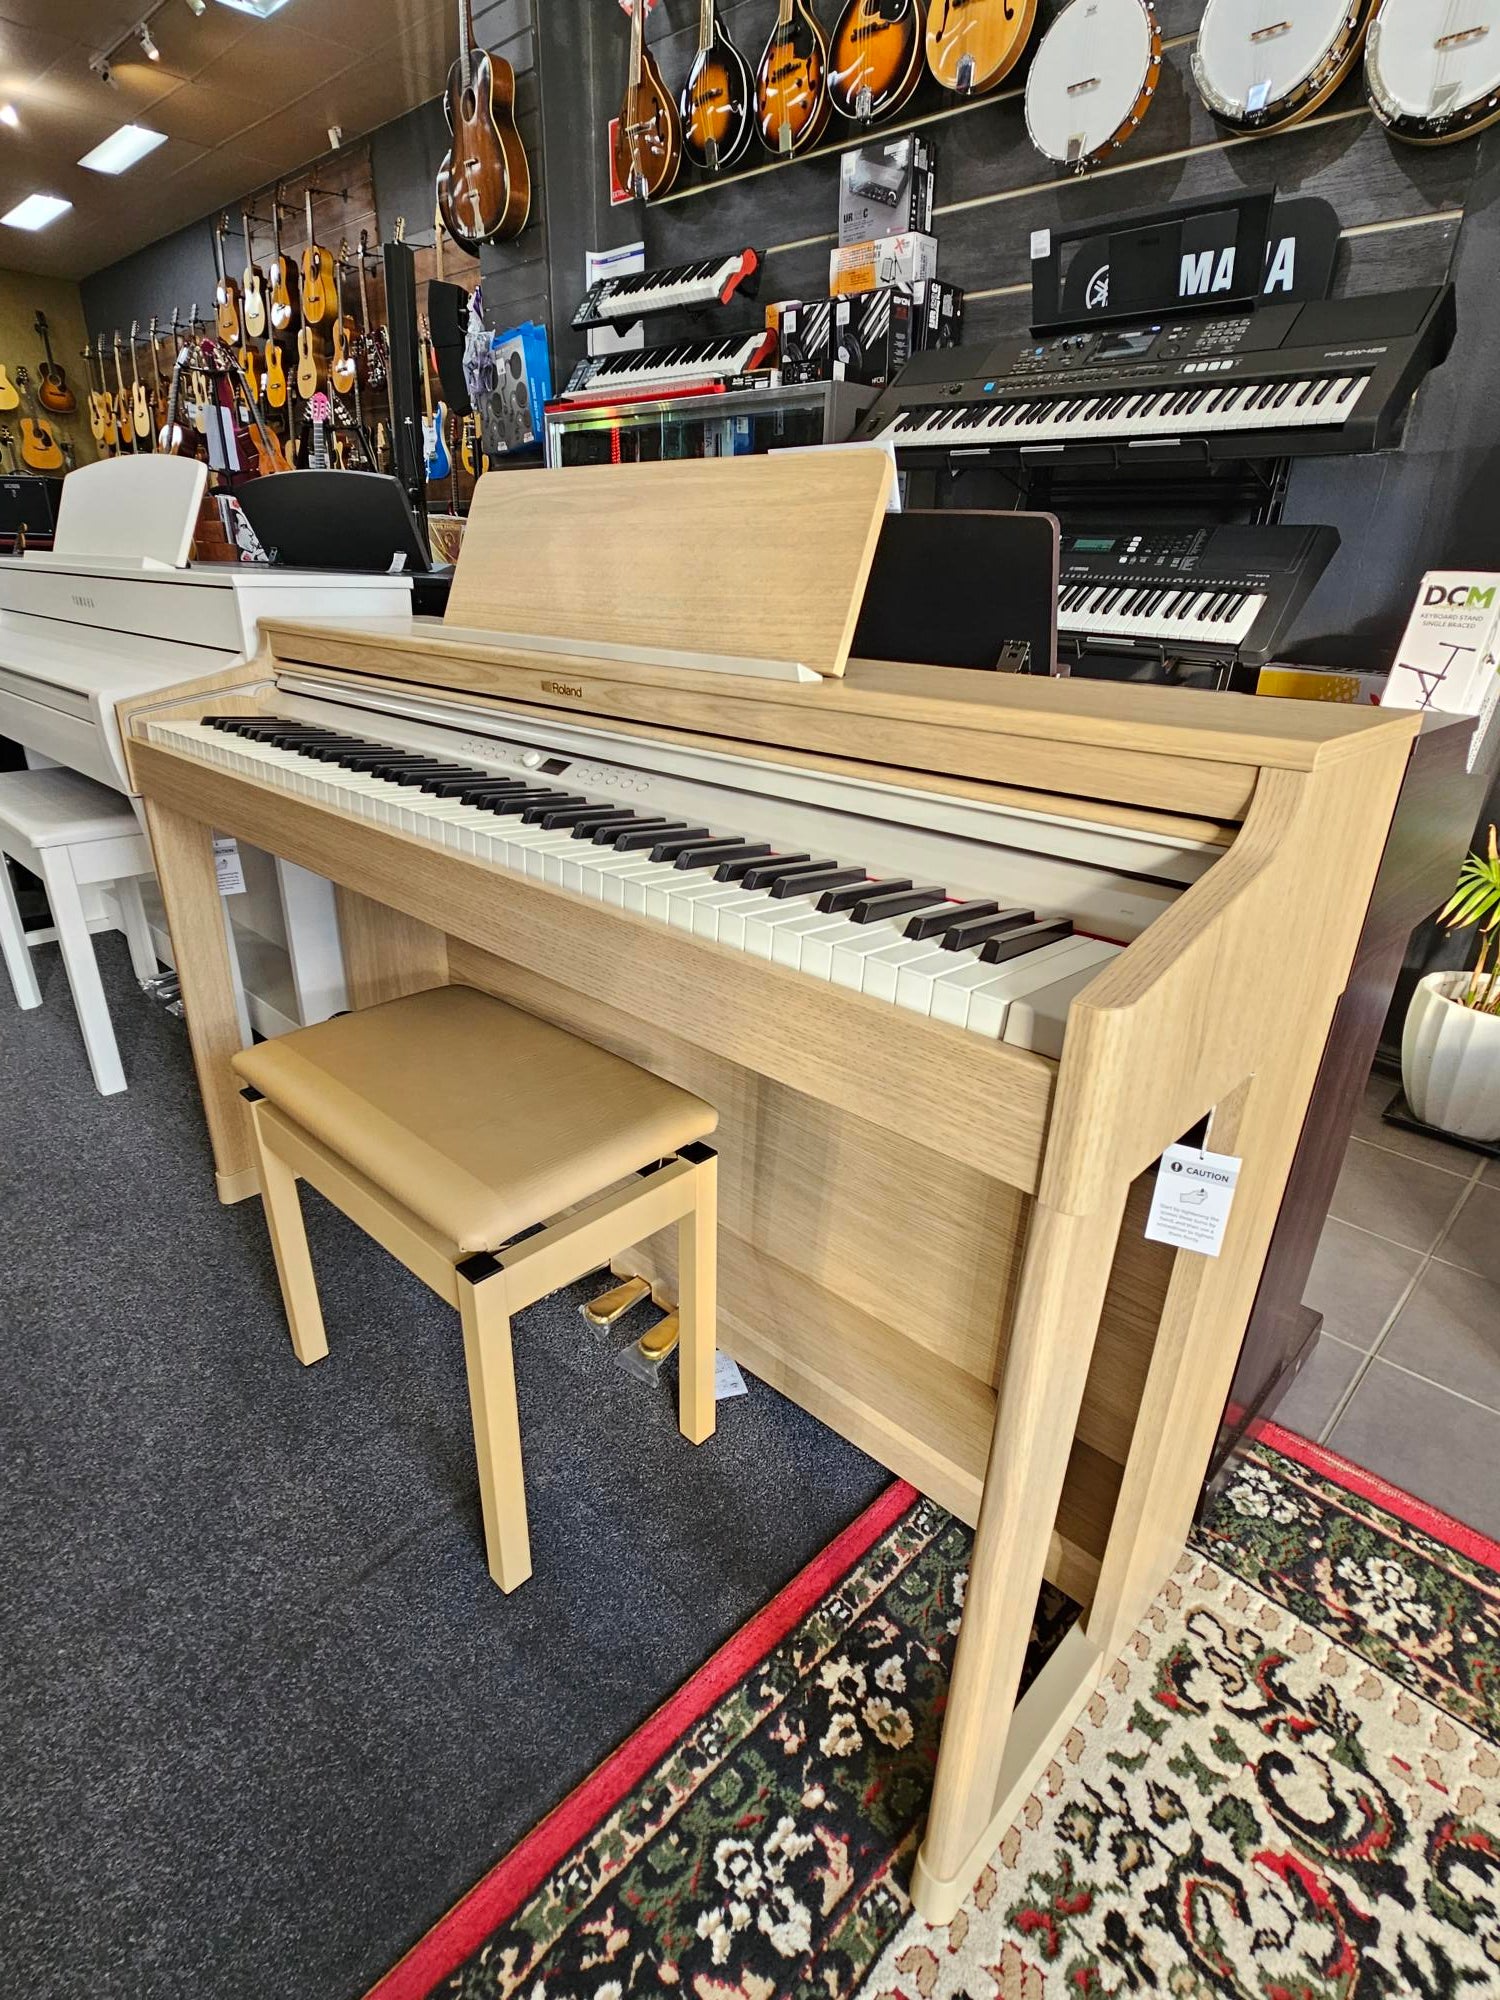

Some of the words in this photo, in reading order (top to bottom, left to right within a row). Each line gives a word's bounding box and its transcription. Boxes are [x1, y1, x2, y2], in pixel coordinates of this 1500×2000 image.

[1423, 585, 1497, 609] DCM
[1421, 613, 1458, 621] KEYBOARD
[1459, 614, 1484, 622] STAND
[1422, 620, 1446, 628] SINGLE
[1447, 621, 1476, 629] BRACED
[552, 682, 583, 698] Roland
[1186, 1167, 1229, 1183] CAUTION
